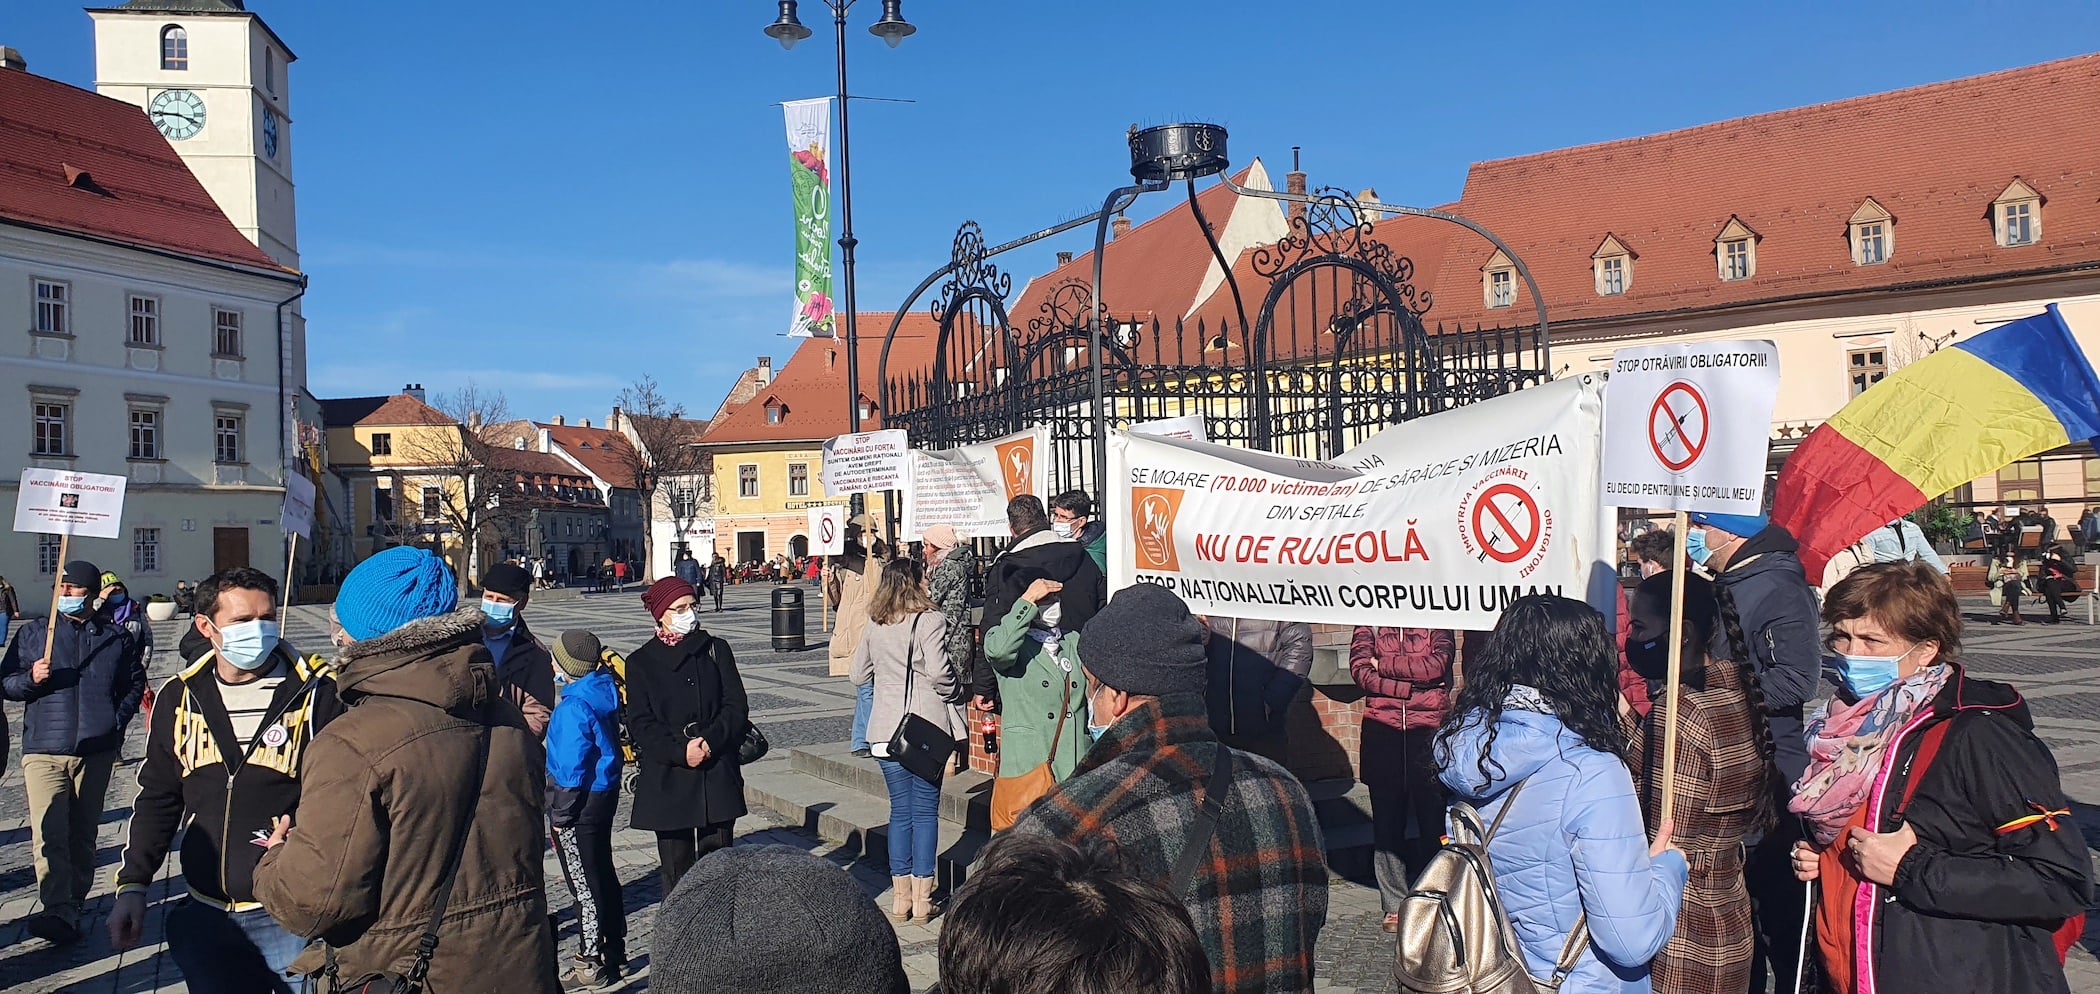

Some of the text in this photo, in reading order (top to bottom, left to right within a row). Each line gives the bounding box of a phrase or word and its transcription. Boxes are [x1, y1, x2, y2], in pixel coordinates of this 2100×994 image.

[1617, 353, 1768, 373] STOP OTRĂVIRII OBLIGATORII!
[855, 436, 871, 445] STOP
[865, 445, 874, 453] CU
[827, 457, 850, 465] SUNTEM
[850, 454, 873, 462] OAMENI
[847, 460, 882, 469] AVEM DREPT
[1131, 434, 1563, 498] SE MOARE (70.000 victime/an) DE SĂRĂCIE ȘI MIZERIA
[843, 466, 897, 476] AUTODETERMINARE
[832, 477, 867, 486] VACCINAREA
[868, 481, 894, 489] ALEGERE
[1607, 482, 1615, 494] EU
[1617, 483, 1640, 495] DECID
[1642, 484, 1673, 496] PENTRU
[1701, 486, 1730, 500] COPILUL
[1731, 487, 1756, 501] MEU!
[1266, 503, 1368, 521] DIN SPITALE,
[1472, 465, 1529, 491] VACCINĂRII
[1519, 509, 1552, 579] OBLIGATORII
[1195, 518, 1430, 566] NU DE RUJEOLĂ
[1181, 578, 1334, 607] NAȚIONALIZĂRII
[1338, 584, 1470, 611] CORPULUI
